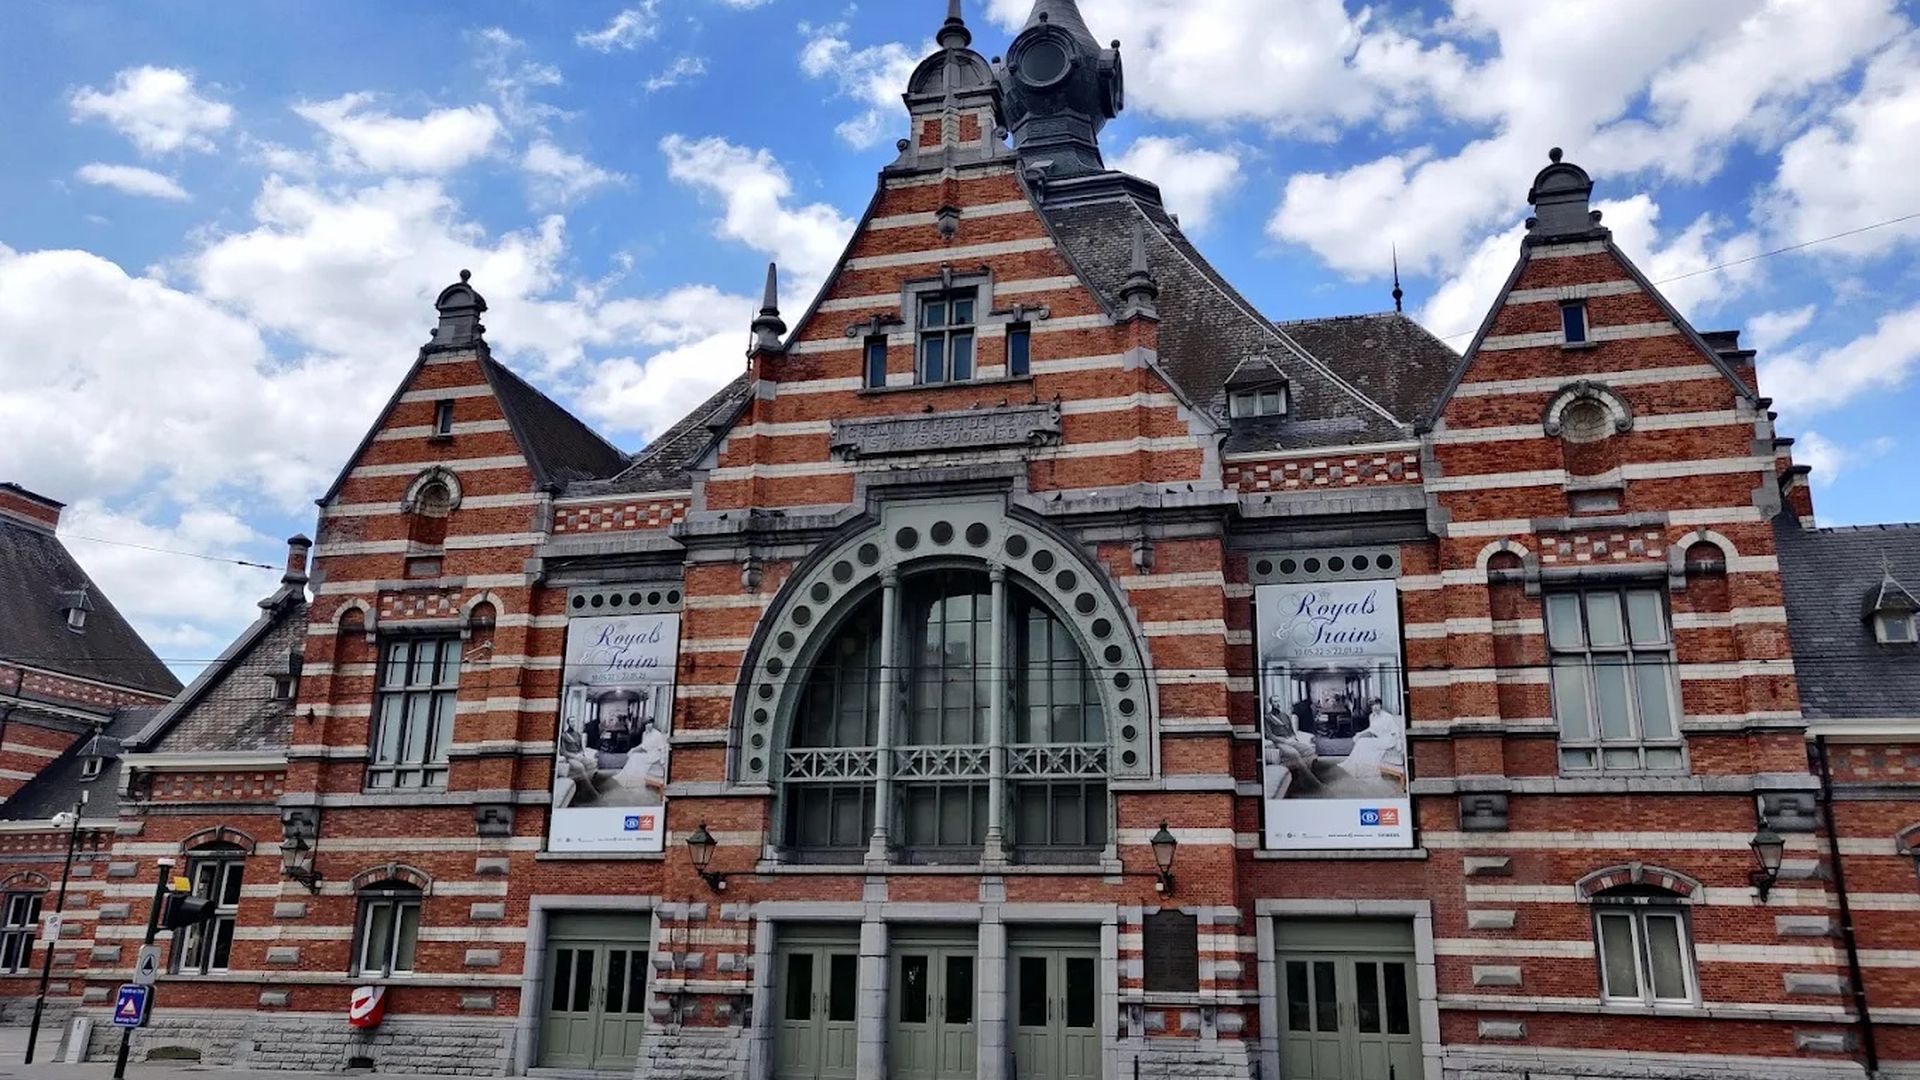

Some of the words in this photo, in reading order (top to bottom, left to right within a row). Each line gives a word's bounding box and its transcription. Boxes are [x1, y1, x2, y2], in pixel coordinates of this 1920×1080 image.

[848, 422, 905, 438] CHEMIN
[909, 420, 929, 433] DE
[934, 418, 963, 432] FER
[968, 415, 988, 429] DE
[1295, 588, 1377, 623] Royals
[595, 622, 663, 653] Royals
[1272, 622, 1290, 639] &
[1308, 616, 1377, 646] Trains
[606, 645, 658, 672] Trains
